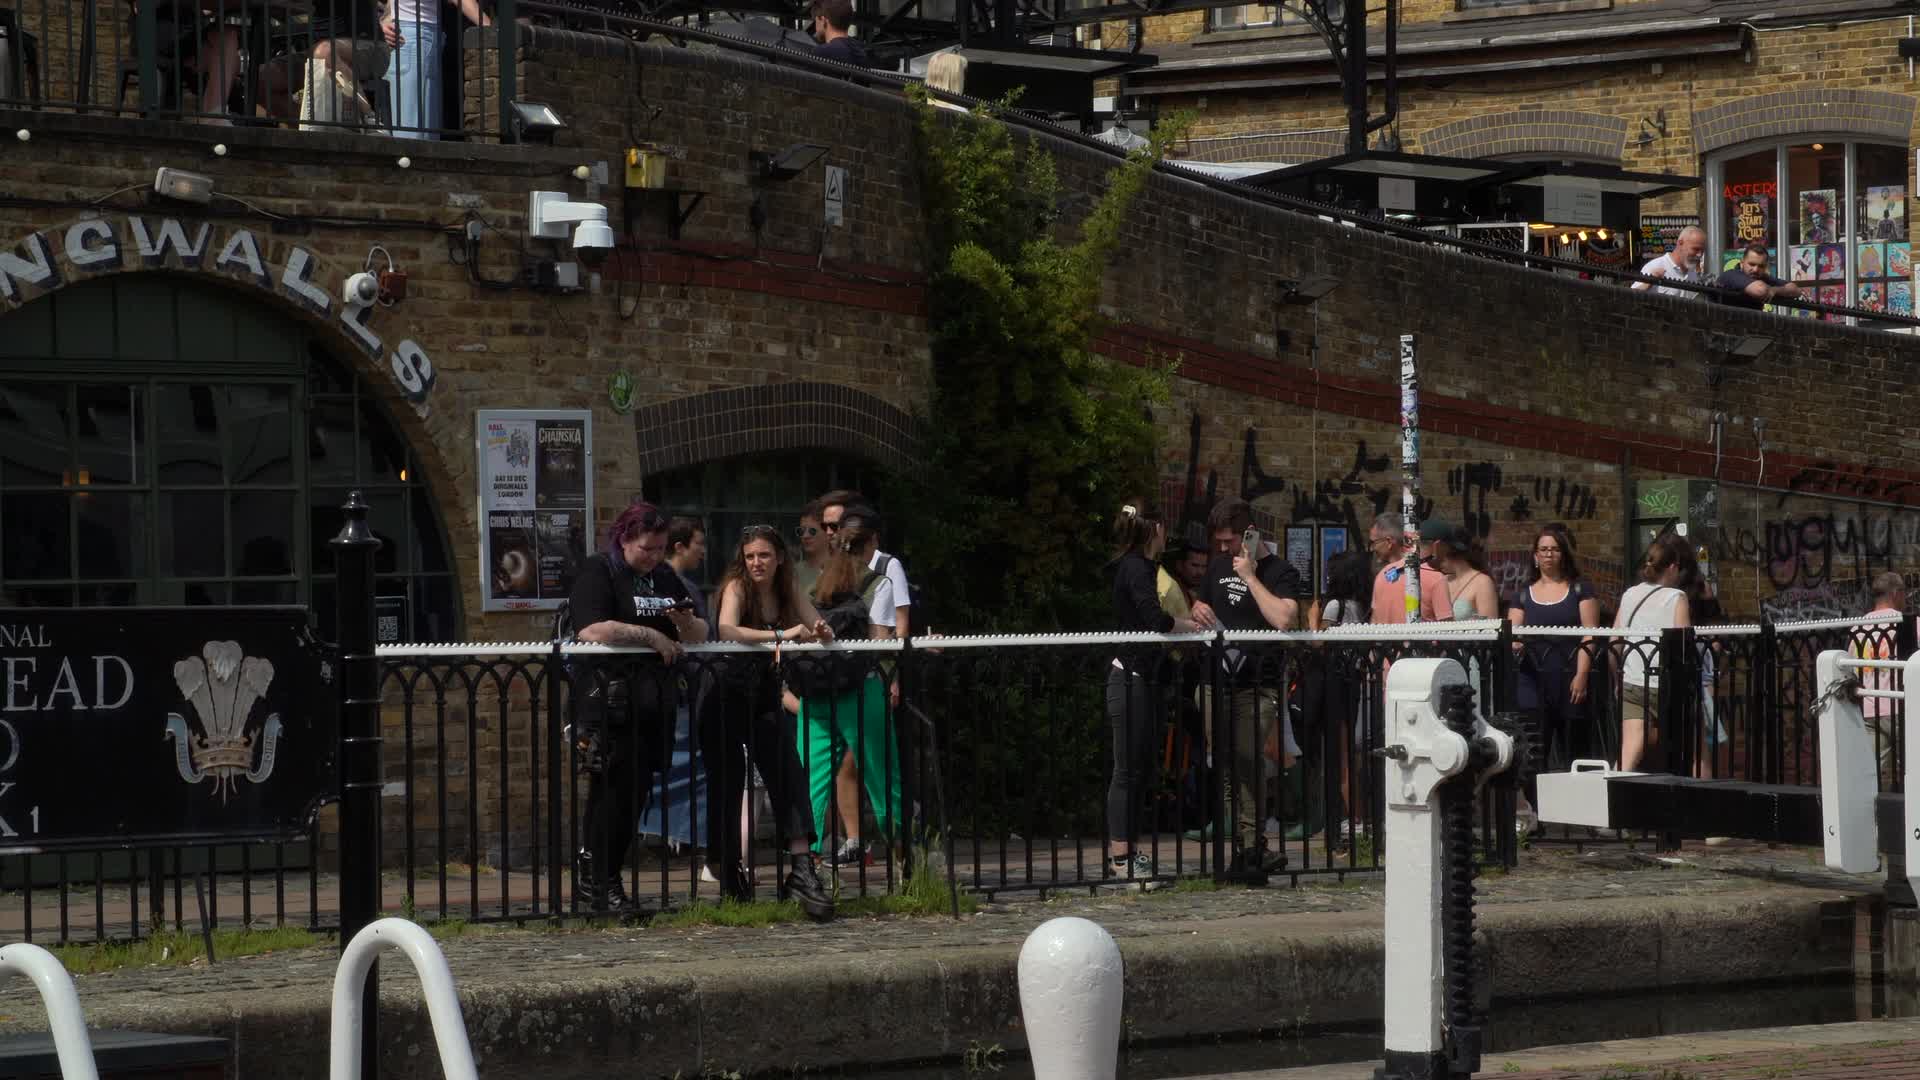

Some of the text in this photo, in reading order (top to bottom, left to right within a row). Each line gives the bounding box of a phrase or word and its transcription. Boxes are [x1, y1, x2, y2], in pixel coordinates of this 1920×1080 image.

[1738, 213, 1763, 229] START
[538, 427, 582, 445] CHAINSKA
[0, 624, 52, 648] NAL
[2, 655, 135, 711] EAD
